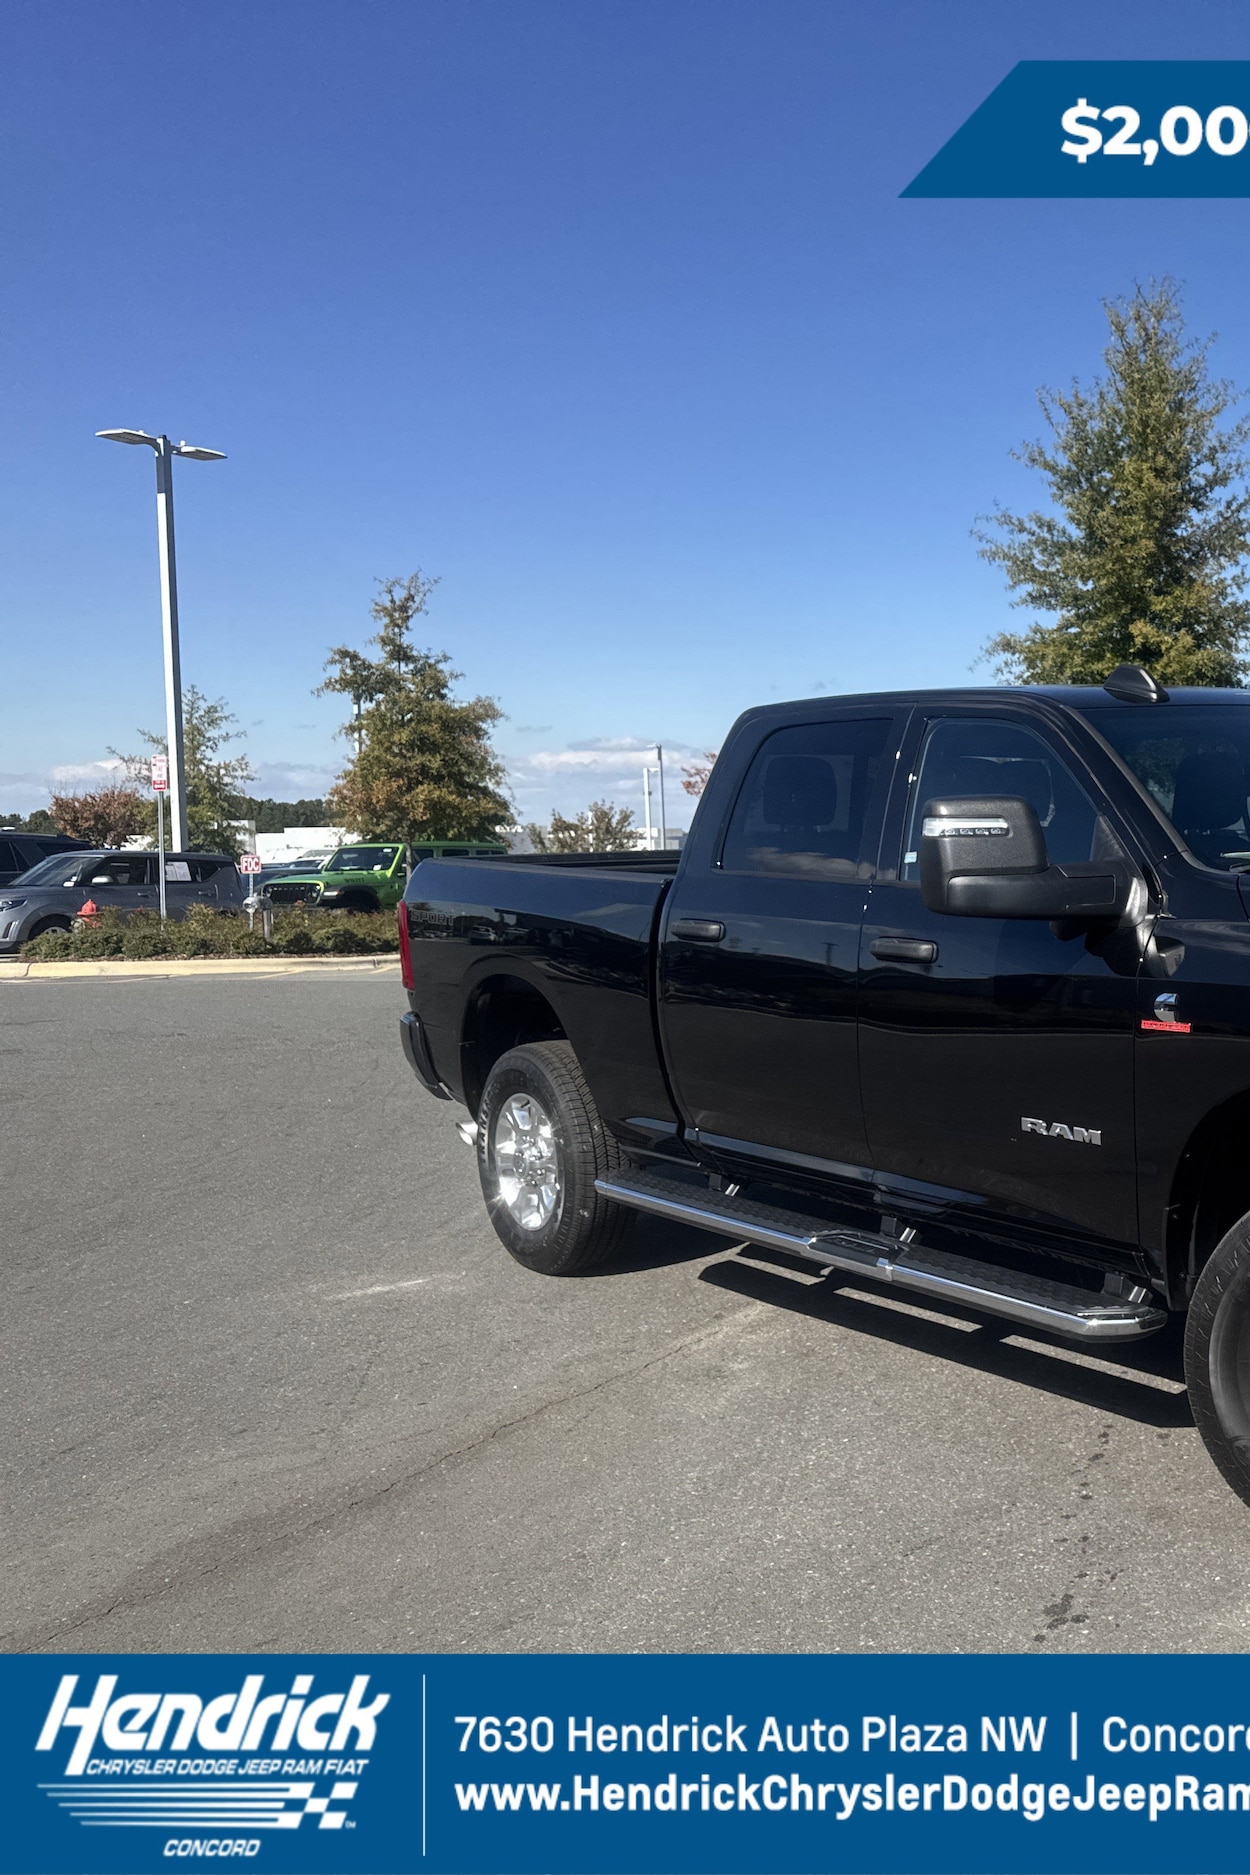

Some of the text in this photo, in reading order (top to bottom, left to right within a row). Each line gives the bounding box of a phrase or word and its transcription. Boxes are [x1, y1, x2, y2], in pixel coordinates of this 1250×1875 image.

[242, 856, 260, 870] FDC
[410, 909, 457, 926] SPORT
[1020, 1116, 1102, 1146] RAM
